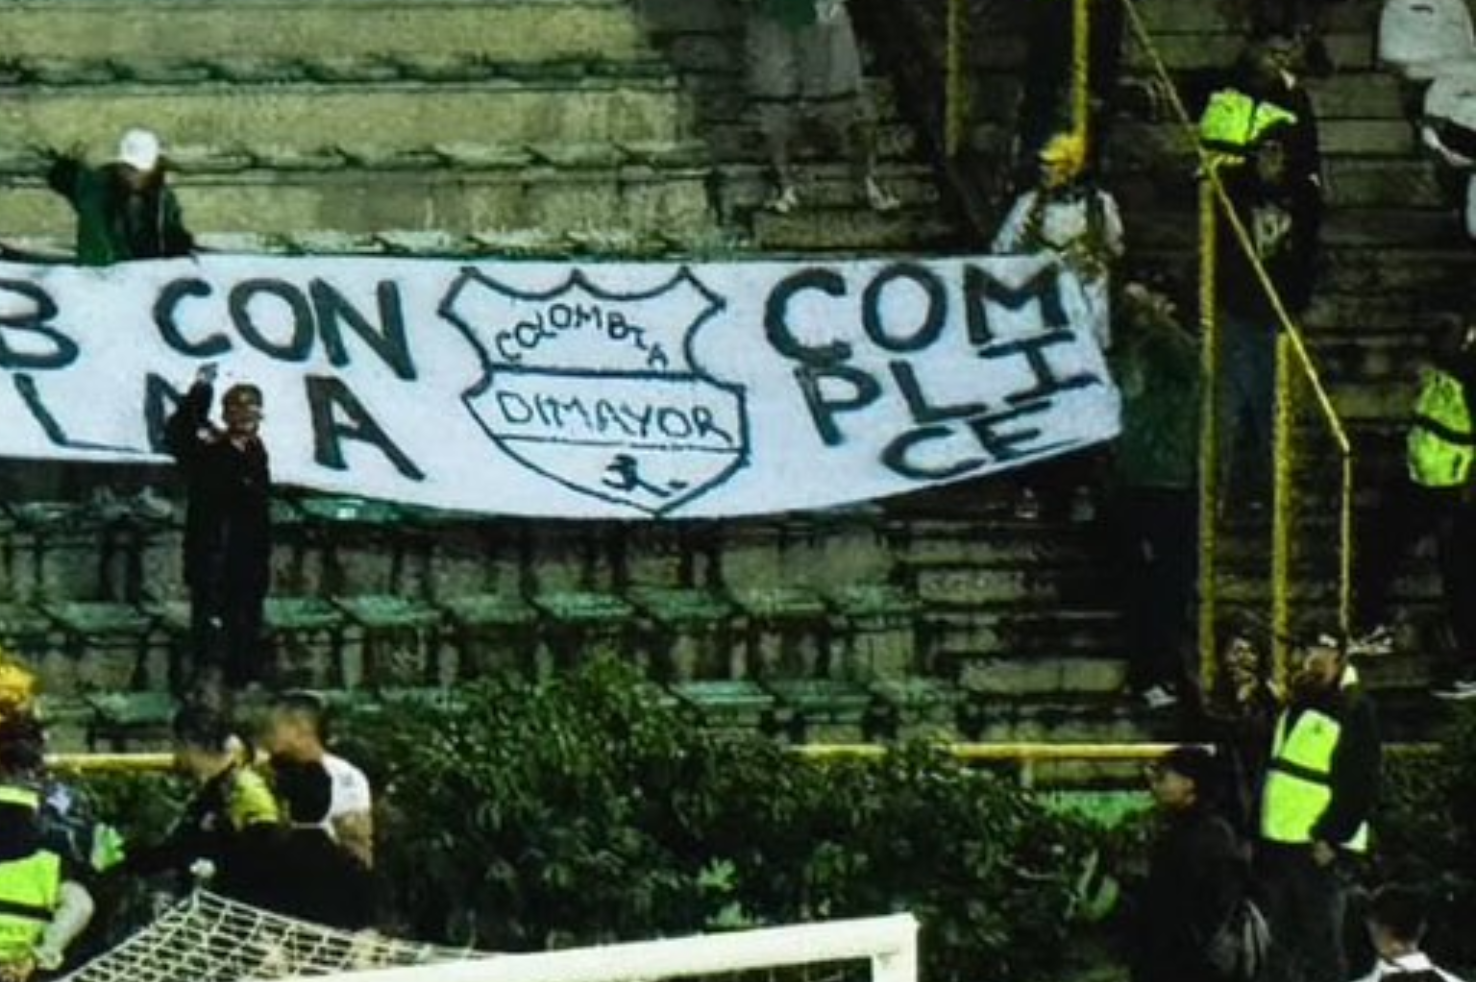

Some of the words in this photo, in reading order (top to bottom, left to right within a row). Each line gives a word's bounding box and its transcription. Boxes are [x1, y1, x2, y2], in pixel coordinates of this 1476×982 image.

[152, 276, 417, 380] CON
[496, 303, 669, 369] COLOMBIA
[763, 261, 1070, 361] COM
[304, 374, 426, 482] A
[496, 391, 734, 445] DIMAYOR
[879, 400, 1082, 480] CE
